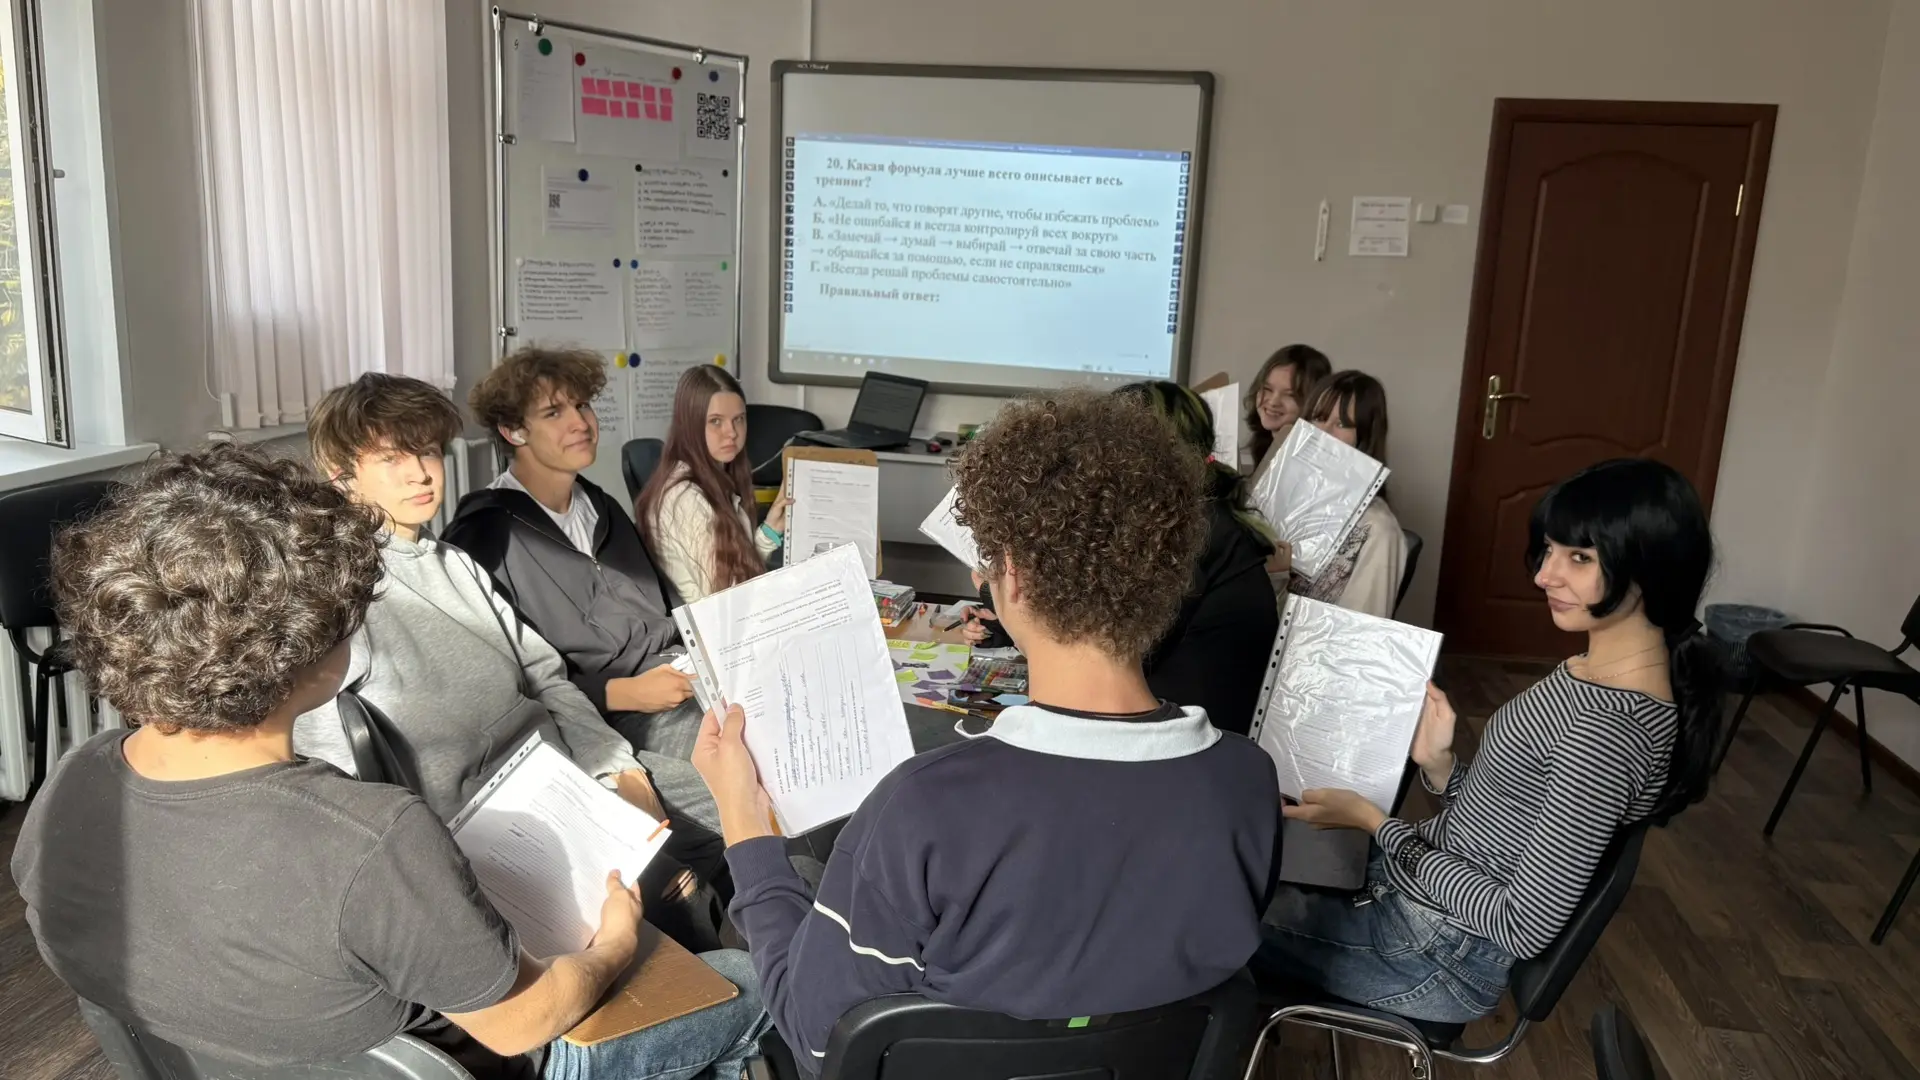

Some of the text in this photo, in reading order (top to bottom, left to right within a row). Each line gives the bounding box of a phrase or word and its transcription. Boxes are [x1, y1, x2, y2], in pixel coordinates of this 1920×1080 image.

[814, 175, 872, 188] тренинг?
[826, 157, 1124, 187] 20. Какая формула лучше всего описывает весь
[812, 196, 827, 208] А.
[874, 202, 890, 212] то,
[892, 202, 912, 213] что
[913, 204, 959, 218] говорят
[960, 205, 1004, 220] другие,
[1006, 208, 1043, 221] чтобы
[1044, 210, 1099, 225] избежать
[1101, 213, 1160, 229] проблем»
[812, 212, 825, 225] Б.
[853, 215, 911, 230] ошибайся
[913, 220, 922, 230] и
[924, 221, 961, 233] всегда
[964, 223, 1039, 239] контролируй
[1042, 228, 1068, 240] всех
[1071, 231, 1119, 244] вокруг»
[811, 228, 824, 241] В.
[900, 235, 936, 248] думай
[956, 238, 1006, 254] выбирай
[1026, 243, 1073, 256] отвечай
[1075, 248, 1088, 257] за
[1090, 248, 1121, 260] свою
[1124, 250, 1157, 262] часть
[827, 245, 890, 260] обращайся
[892, 252, 905, 261] за
[907, 253, 967, 267] помощью,
[969, 256, 997, 267] если
[999, 257, 1014, 268] не
[809, 260, 821, 273] Г.
[871, 266, 909, 279] решай
[911, 267, 969, 283] проблемы
[972, 275, 1073, 289] самостоятельно»
[819, 282, 940, 302] Правильный ответ:
